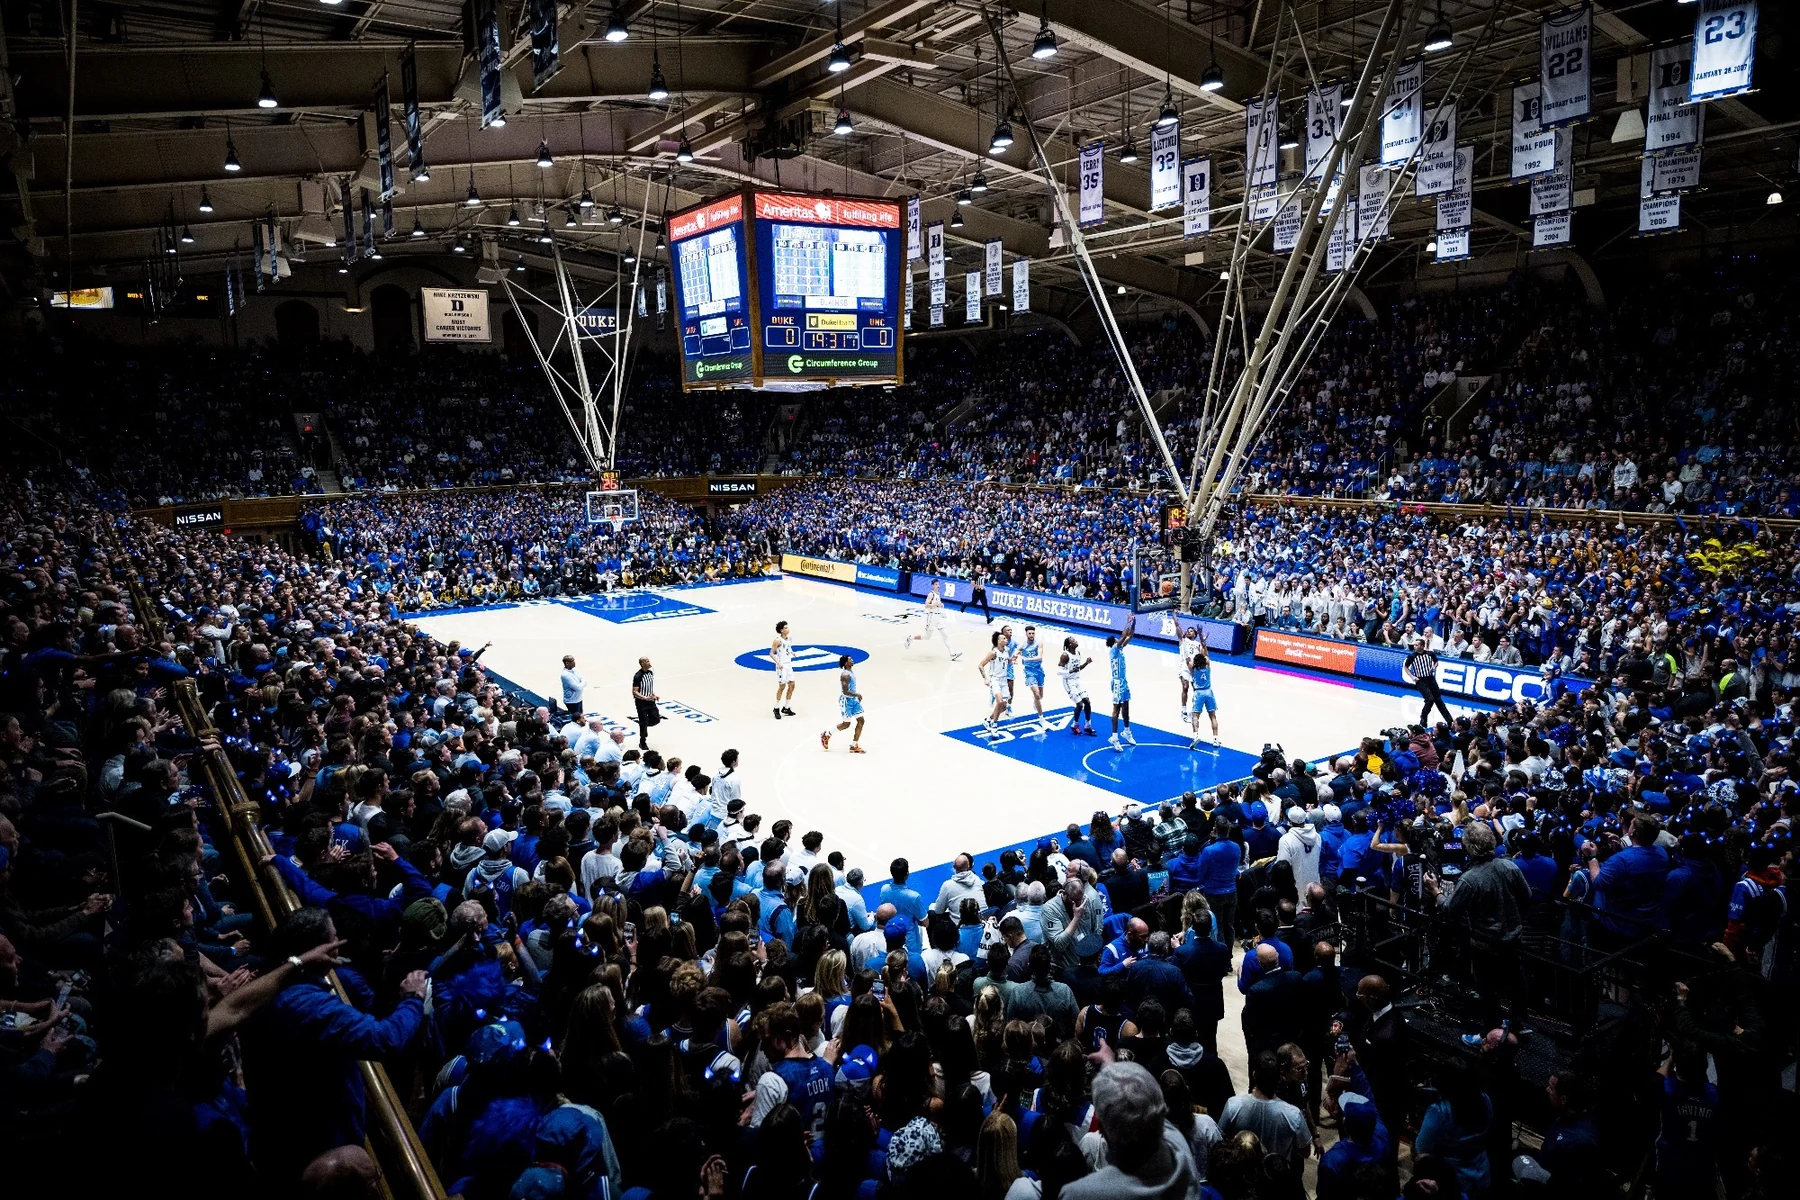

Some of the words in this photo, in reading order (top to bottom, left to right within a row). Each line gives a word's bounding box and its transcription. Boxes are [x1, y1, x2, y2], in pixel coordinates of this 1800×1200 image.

[1705, 10, 1747, 45] 23
[1545, 25, 1588, 51] WILLIAMS
[1548, 48, 1583, 80] 22
[1696, 68, 1722, 80] JANUARY
[1388, 76, 1419, 96] ATTIER
[1650, 112, 1671, 124] FINAL
[1674, 108, 1696, 118] FOUR
[1661, 132, 1680, 142] 1994
[1514, 144, 1532, 154] FINAL
[1534, 138, 1553, 149] FOUR
[1156, 152, 1174, 172] 32
[1428, 152, 1444, 160] NCAA
[1658, 156, 1698, 168] CHAMPIONS
[1083, 158, 1099, 172] FERRY
[1418, 164, 1434, 173] FINAL
[1435, 160, 1452, 170] FOUR
[1524, 160, 1541, 170] 1992
[1083, 172, 1099, 190] 35
[1427, 181, 1442, 190] 1991
[1668, 176, 1686, 184] 1979
[1533, 183, 1566, 194] CHAMPIONS
[1440, 200, 1469, 210] CHAMPIONS
[1643, 200, 1678, 210] CHAMPIONS
[762, 204, 815, 219] Ameritas
[843, 209, 878, 222] fulfilling
[450, 300, 464, 312] D
[580, 316, 616, 328] DUKE
[772, 316, 794, 325] DUKE
[786, 328, 794, 345] 0
[812, 332, 846, 349] 19:31
[880, 330, 888, 346] 0
[806, 358, 856, 368] Circumference
[858, 358, 878, 368] Group
[603, 479, 616, 490] 26
[710, 484, 756, 492] NISSAN
[176, 512, 221, 524] NISSAN
[800, 559, 830, 574] Continental
[992, 591, 1024, 607] DUKE
[1026, 596, 1112, 626] BASKETBALL
[1189, 646, 1194, 654] 3
[1316, 644, 1330, 652] cheer
[1331, 648, 1354, 656] together
[1200, 672, 1208, 680] 4
[1402, 656, 1544, 704] EICO
[806, 1077, 830, 1096] COOK
[1676, 1104, 1713, 1119] IRVING
[810, 1101, 826, 1141] 2
[1686, 1120, 1698, 1142] 1
